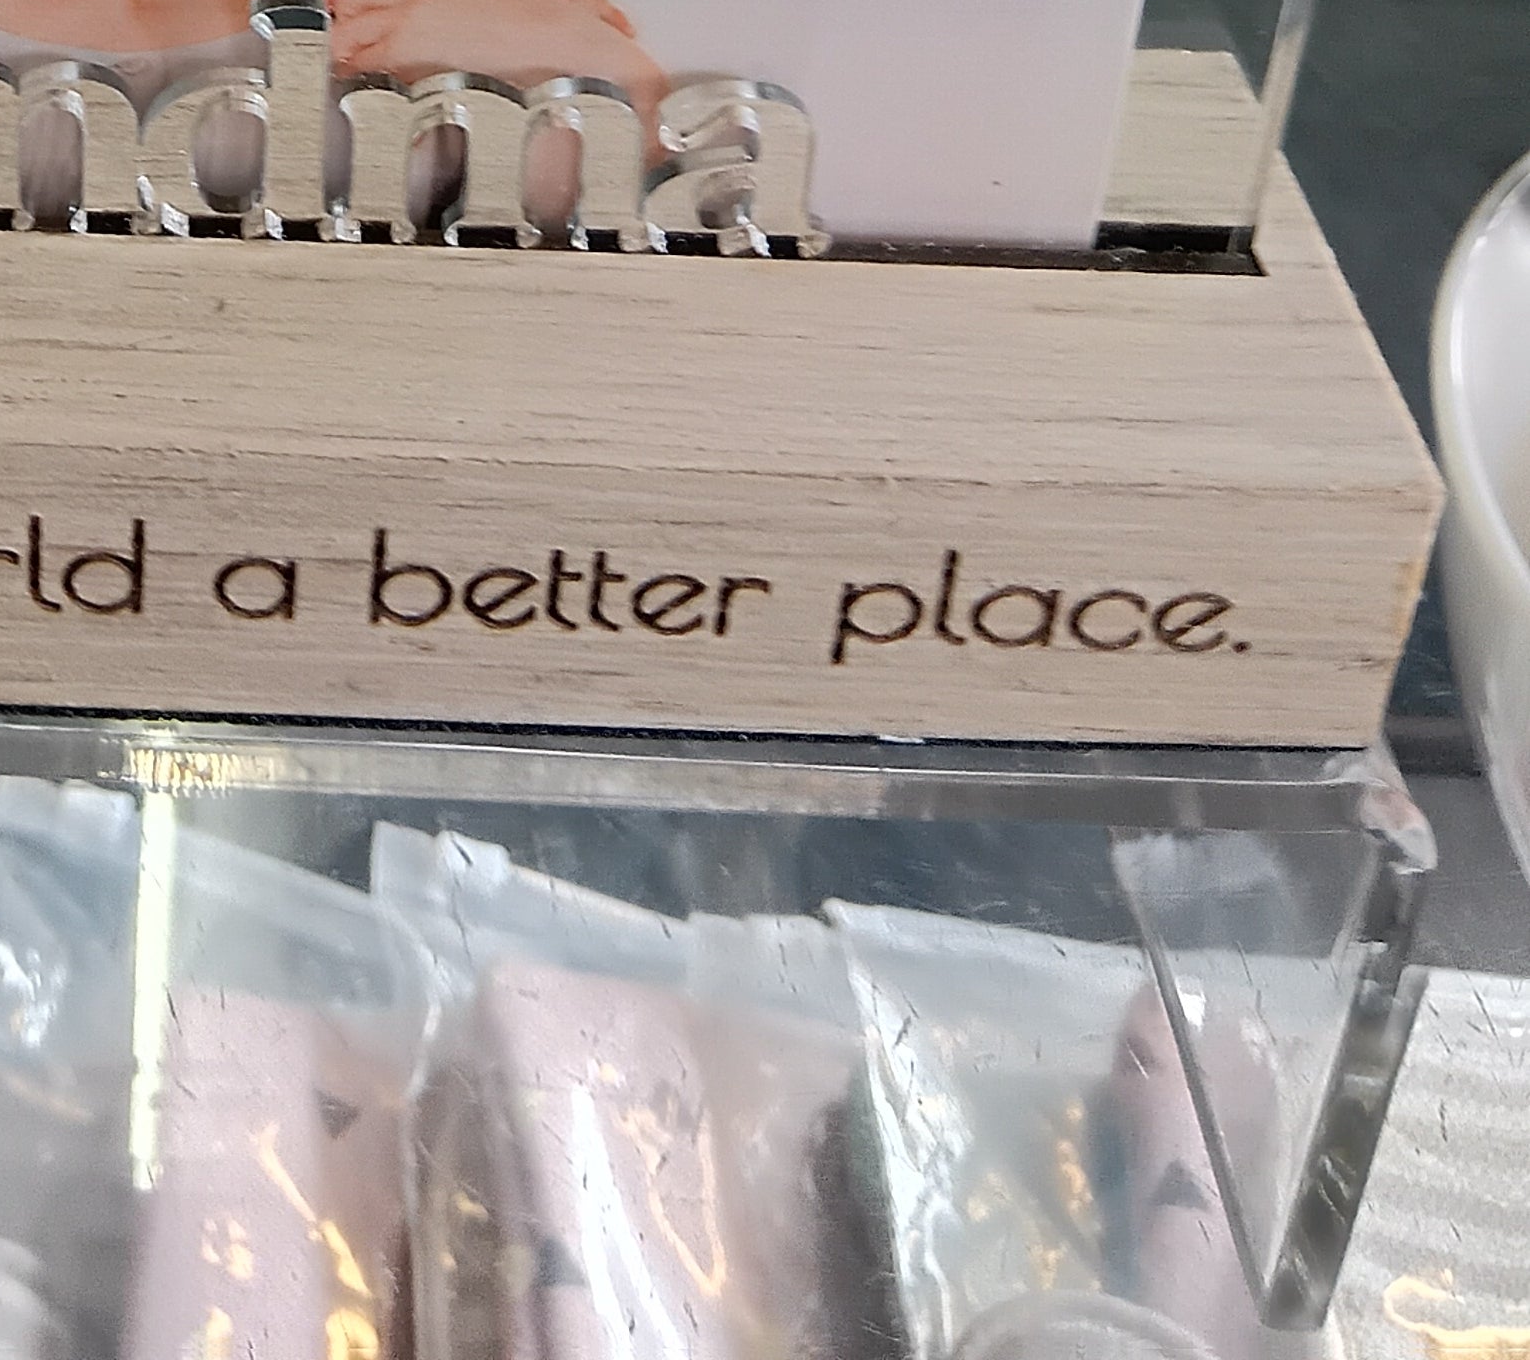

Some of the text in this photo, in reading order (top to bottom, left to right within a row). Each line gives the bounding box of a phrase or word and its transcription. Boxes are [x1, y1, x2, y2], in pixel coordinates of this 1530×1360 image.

[213, 553, 297, 622] a
[370, 526, 772, 637] better
[833, 548, 1253, 665] place.
